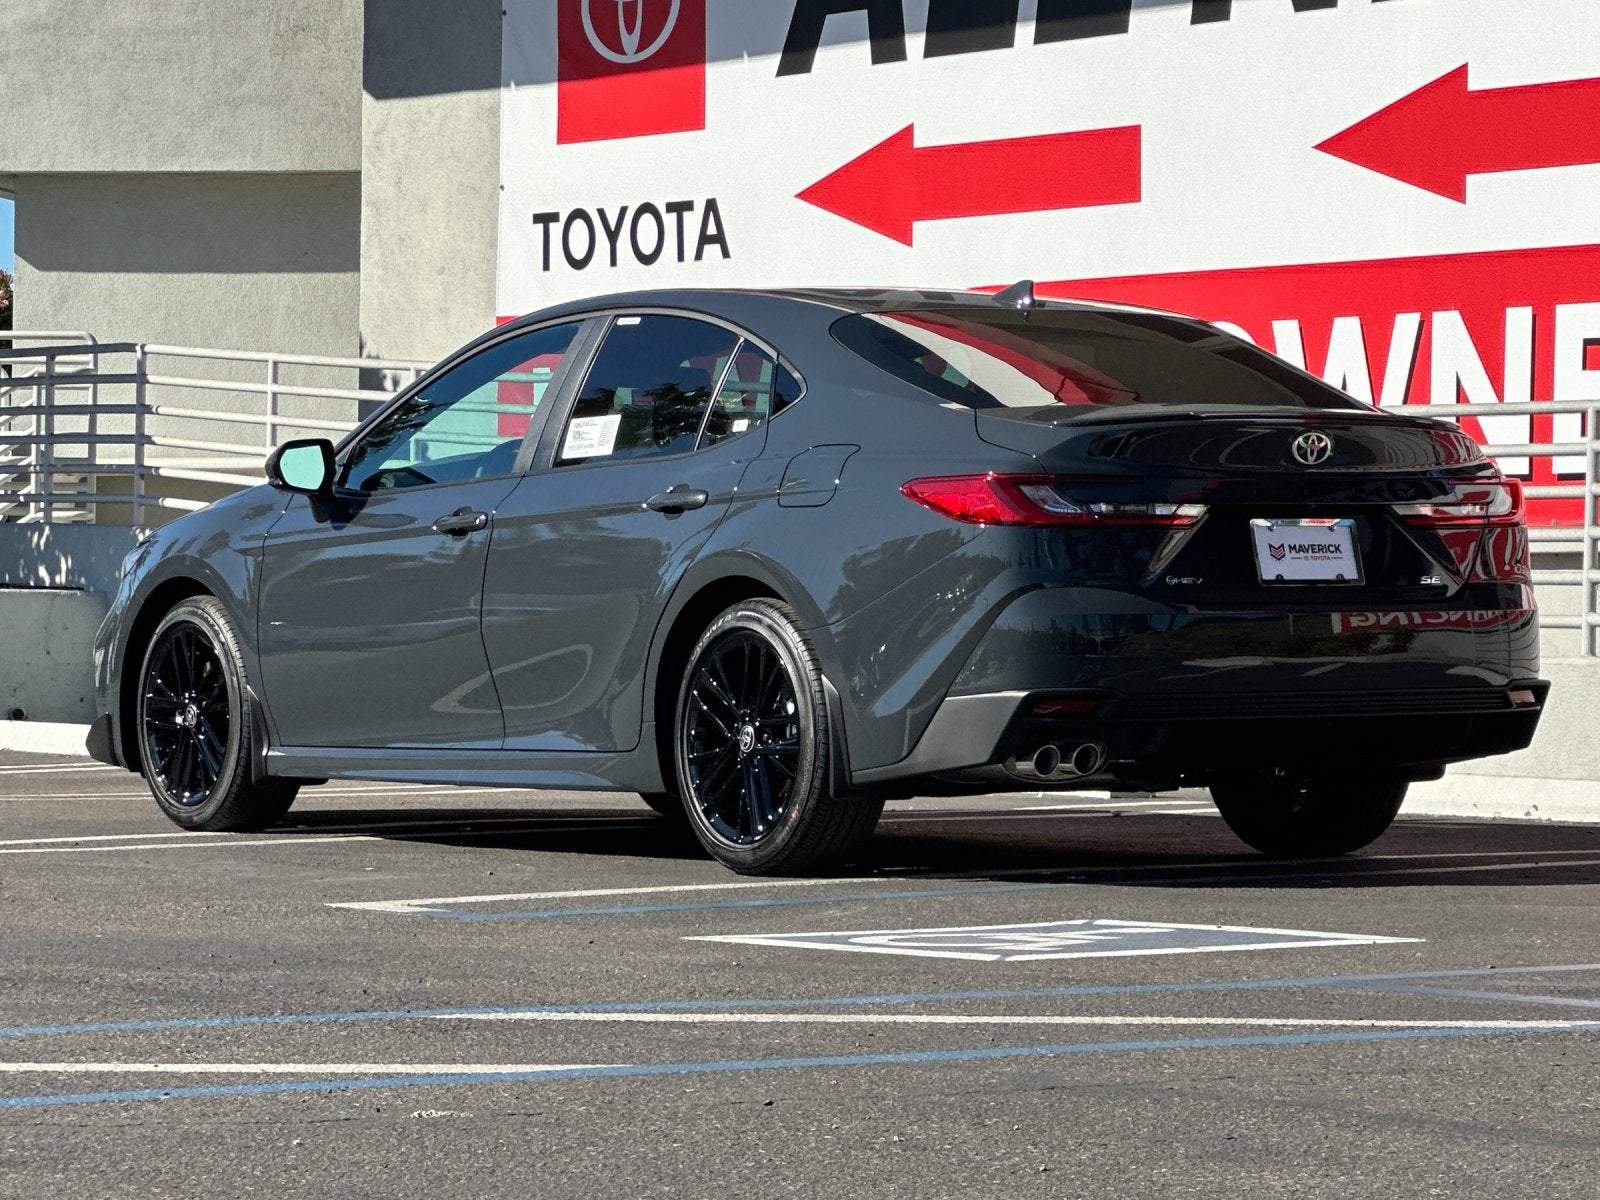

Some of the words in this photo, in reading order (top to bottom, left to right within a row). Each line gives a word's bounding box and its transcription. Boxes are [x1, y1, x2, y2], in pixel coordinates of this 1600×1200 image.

[533, 197, 731, 271] TOYOTA
[1208, 302, 1600, 476] WNE
[1288, 543, 1342, 554] MAVERICK
[1420, 575, 1441, 584] SE
